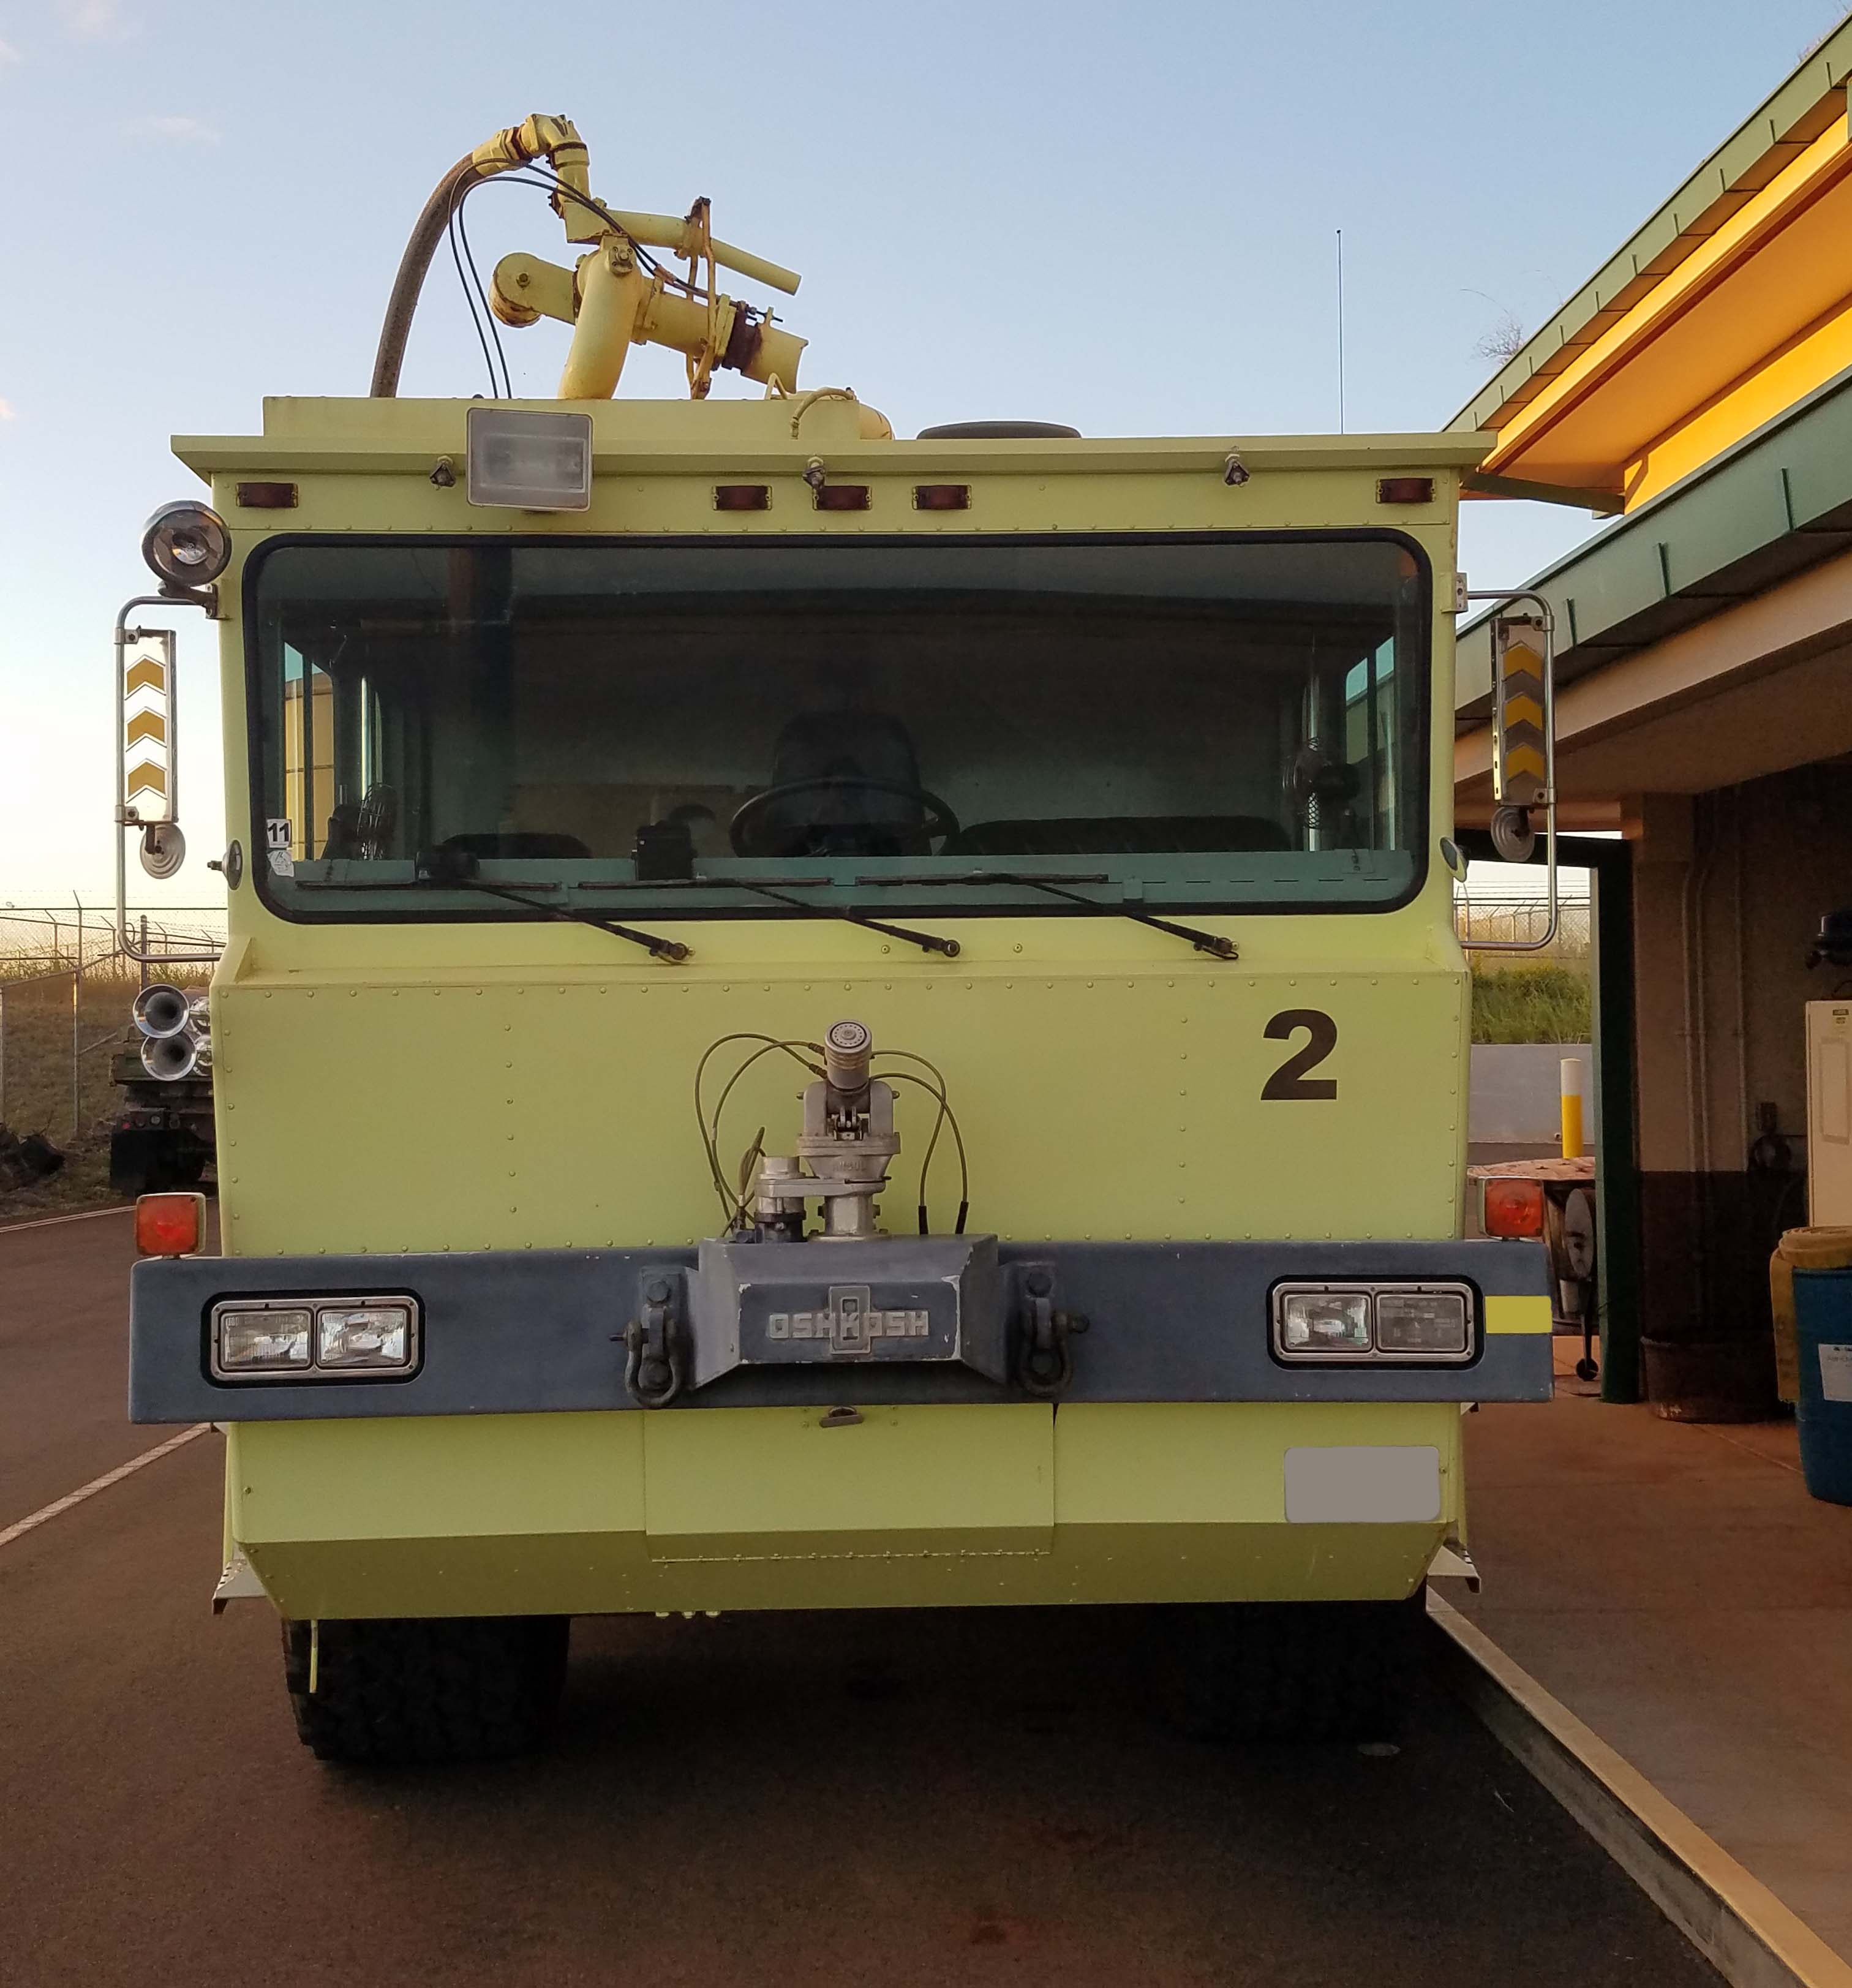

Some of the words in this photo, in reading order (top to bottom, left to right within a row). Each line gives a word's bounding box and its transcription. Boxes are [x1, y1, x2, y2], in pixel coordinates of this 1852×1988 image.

[268, 823, 289, 842] 11
[1260, 1009, 1338, 1101] 2
[769, 1309, 930, 1339] OSHKOSH
